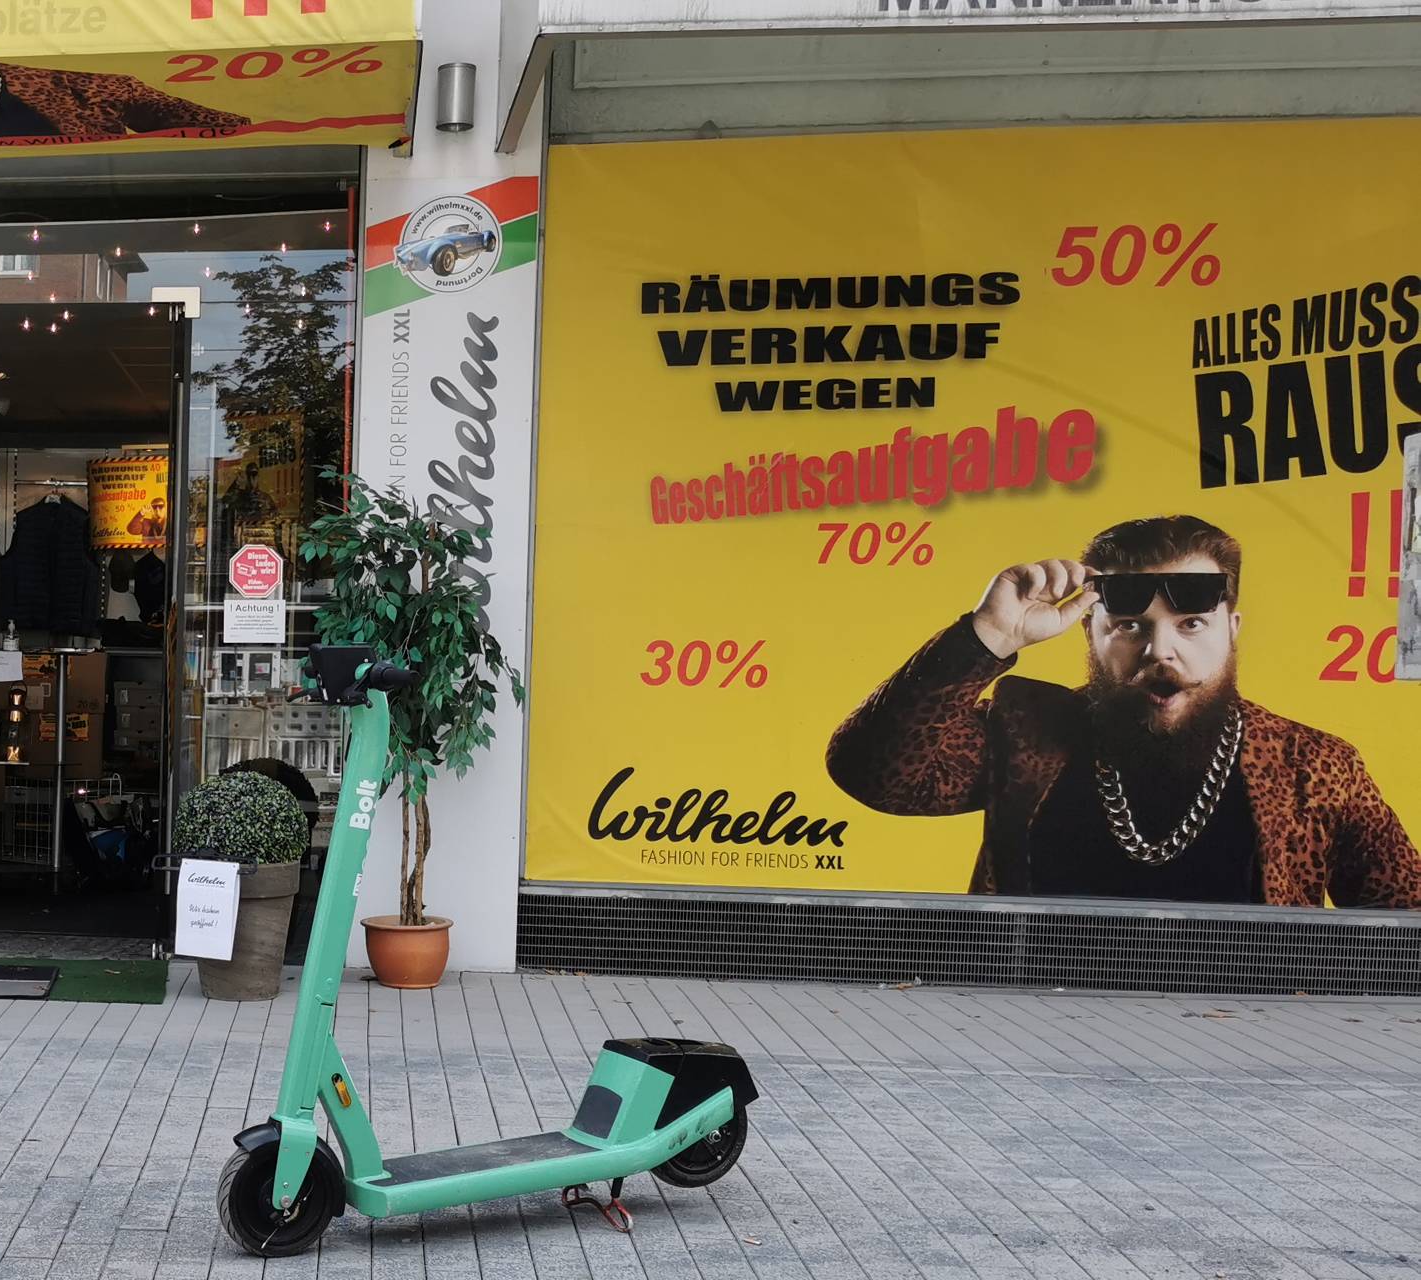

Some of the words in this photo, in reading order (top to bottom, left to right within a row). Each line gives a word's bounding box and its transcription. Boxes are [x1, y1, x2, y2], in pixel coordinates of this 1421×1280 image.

[165, 45, 383, 82] 20%
[411, 201, 483, 234] www.wilhelmxxl.de
[435, 266, 484, 287] Dortmund
[1050, 222, 1222, 287] 50%
[640, 271, 1021, 315] RÄUMUNGS
[393, 309, 411, 344] XXL
[1192, 303, 1282, 369] ALLES
[1291, 275, 1421, 357] MUSS
[657, 322, 1001, 367] VERKAUF
[392, 352, 410, 426] FRIENDS
[714, 376, 937, 412] WEGEN
[390, 433, 408, 476] FOR
[649, 405, 1098, 525] Geschäftsaufgabe
[817, 521, 935, 566] 70%
[235, 604, 274, 613] Achtung
[639, 639, 768, 689] 30%
[349, 779, 378, 830] Bolt
[587, 766, 849, 848] Wilhelm
[640, 849, 705, 866] FASHION
[711, 851, 739, 867] FOR
[745, 852, 809, 869] FRIENDS
[814, 855, 845, 870] XXL
